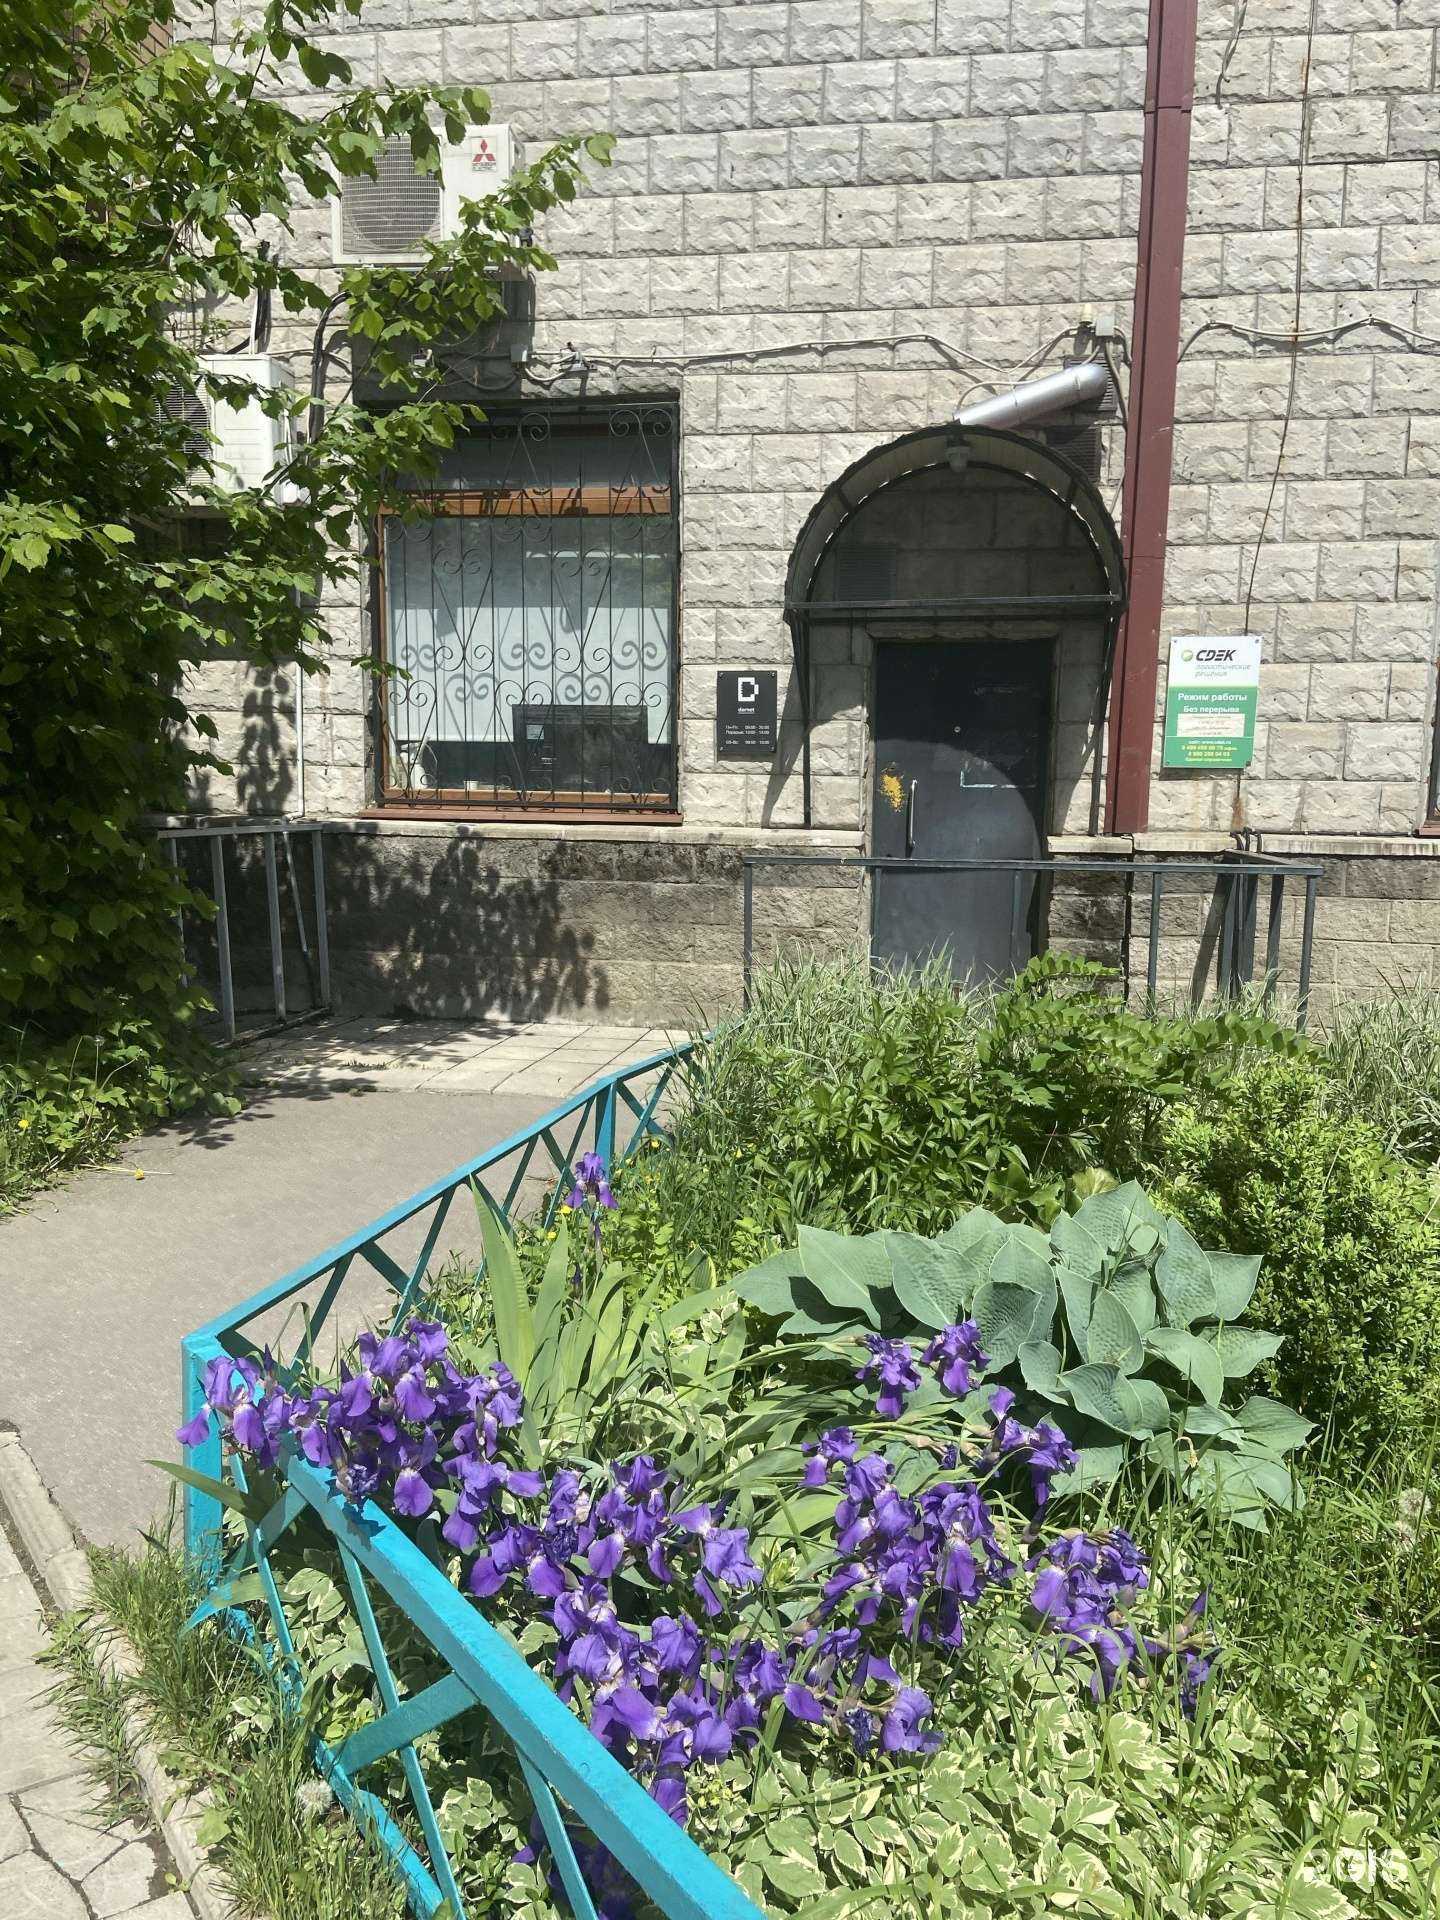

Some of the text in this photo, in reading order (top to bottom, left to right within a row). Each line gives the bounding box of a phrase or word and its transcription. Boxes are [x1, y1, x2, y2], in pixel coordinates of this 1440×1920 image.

[1196, 649, 1236, 662] CDEK
[1177, 692, 1248, 703] Режим работы
[1183, 705, 1240, 715] Без перерыва
